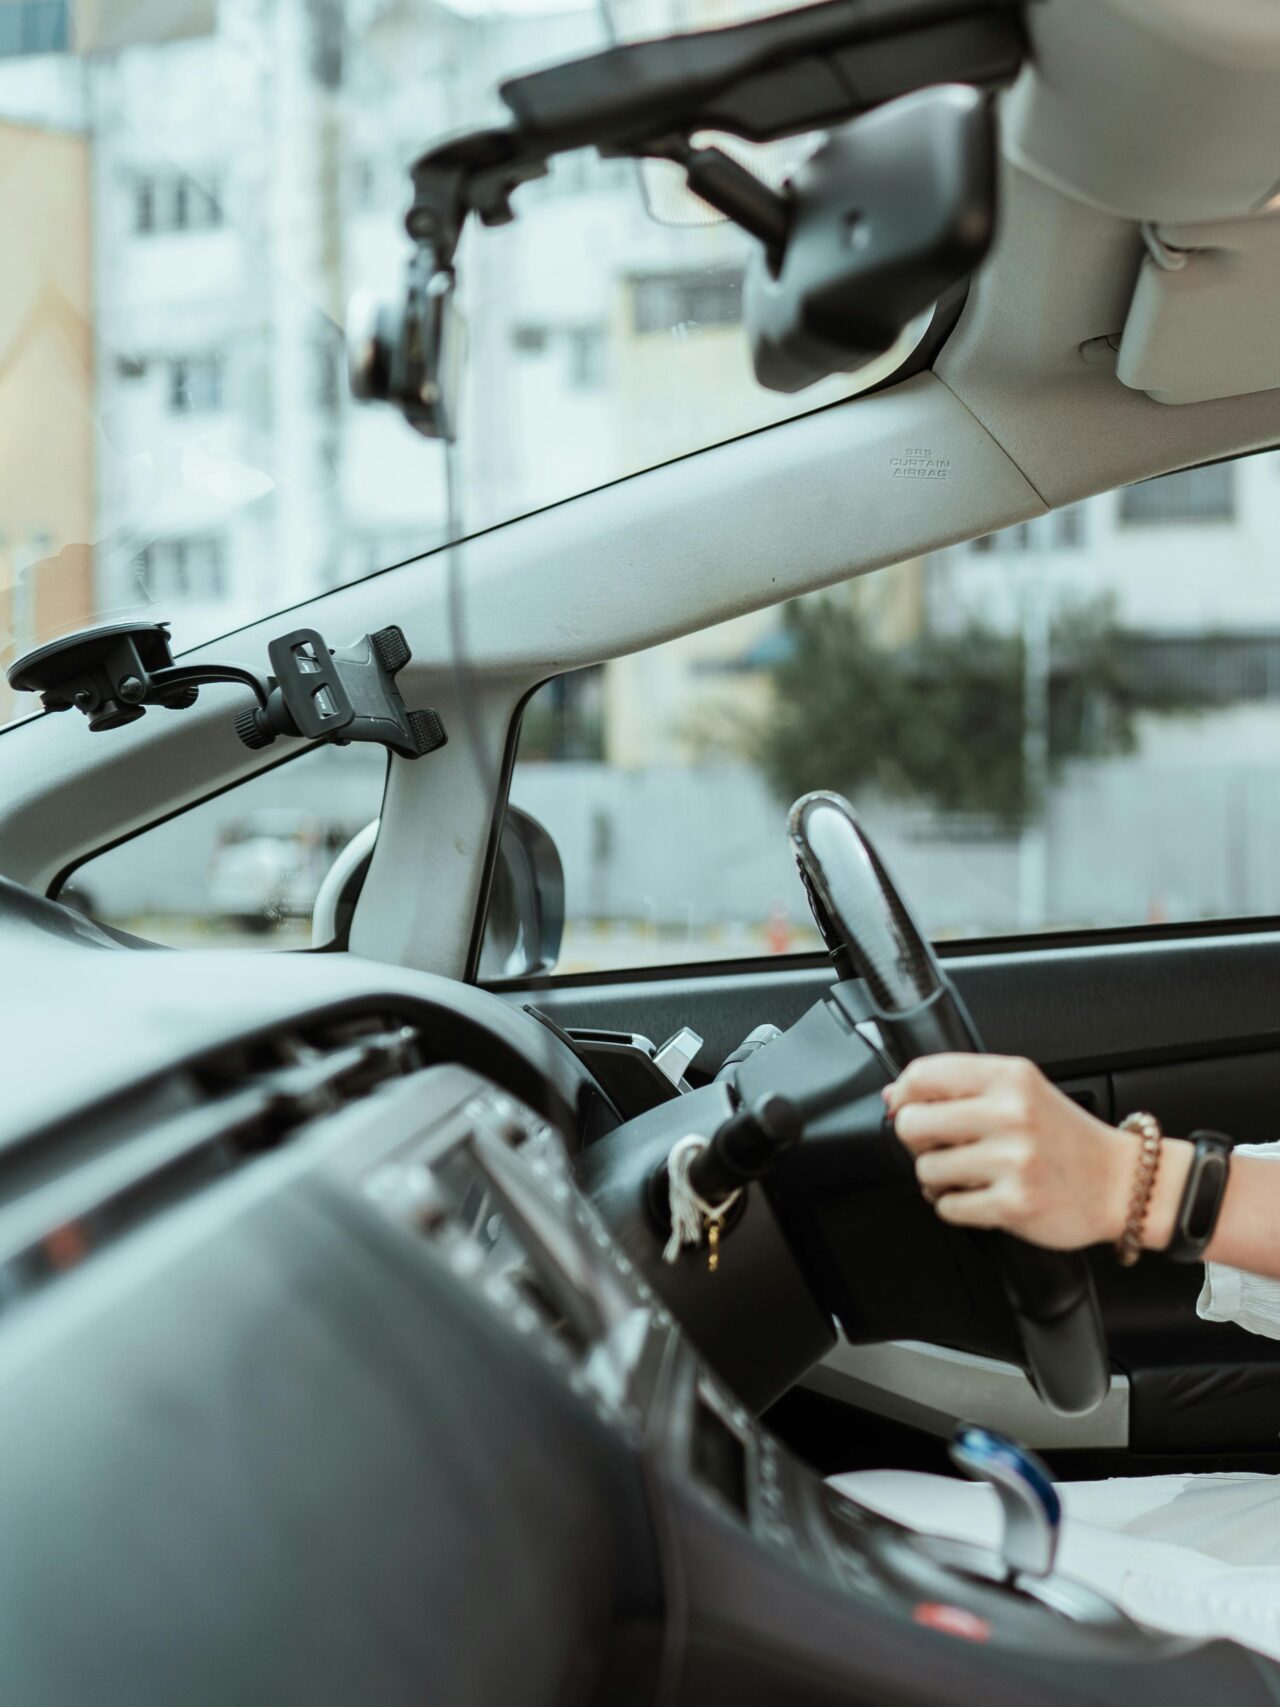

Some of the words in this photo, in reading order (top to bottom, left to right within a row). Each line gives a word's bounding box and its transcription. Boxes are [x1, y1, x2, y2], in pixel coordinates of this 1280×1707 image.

[905, 448, 932, 456] SRS
[890, 457, 949, 468] CURTAIN
[893, 468, 947, 477] AIRBAG
